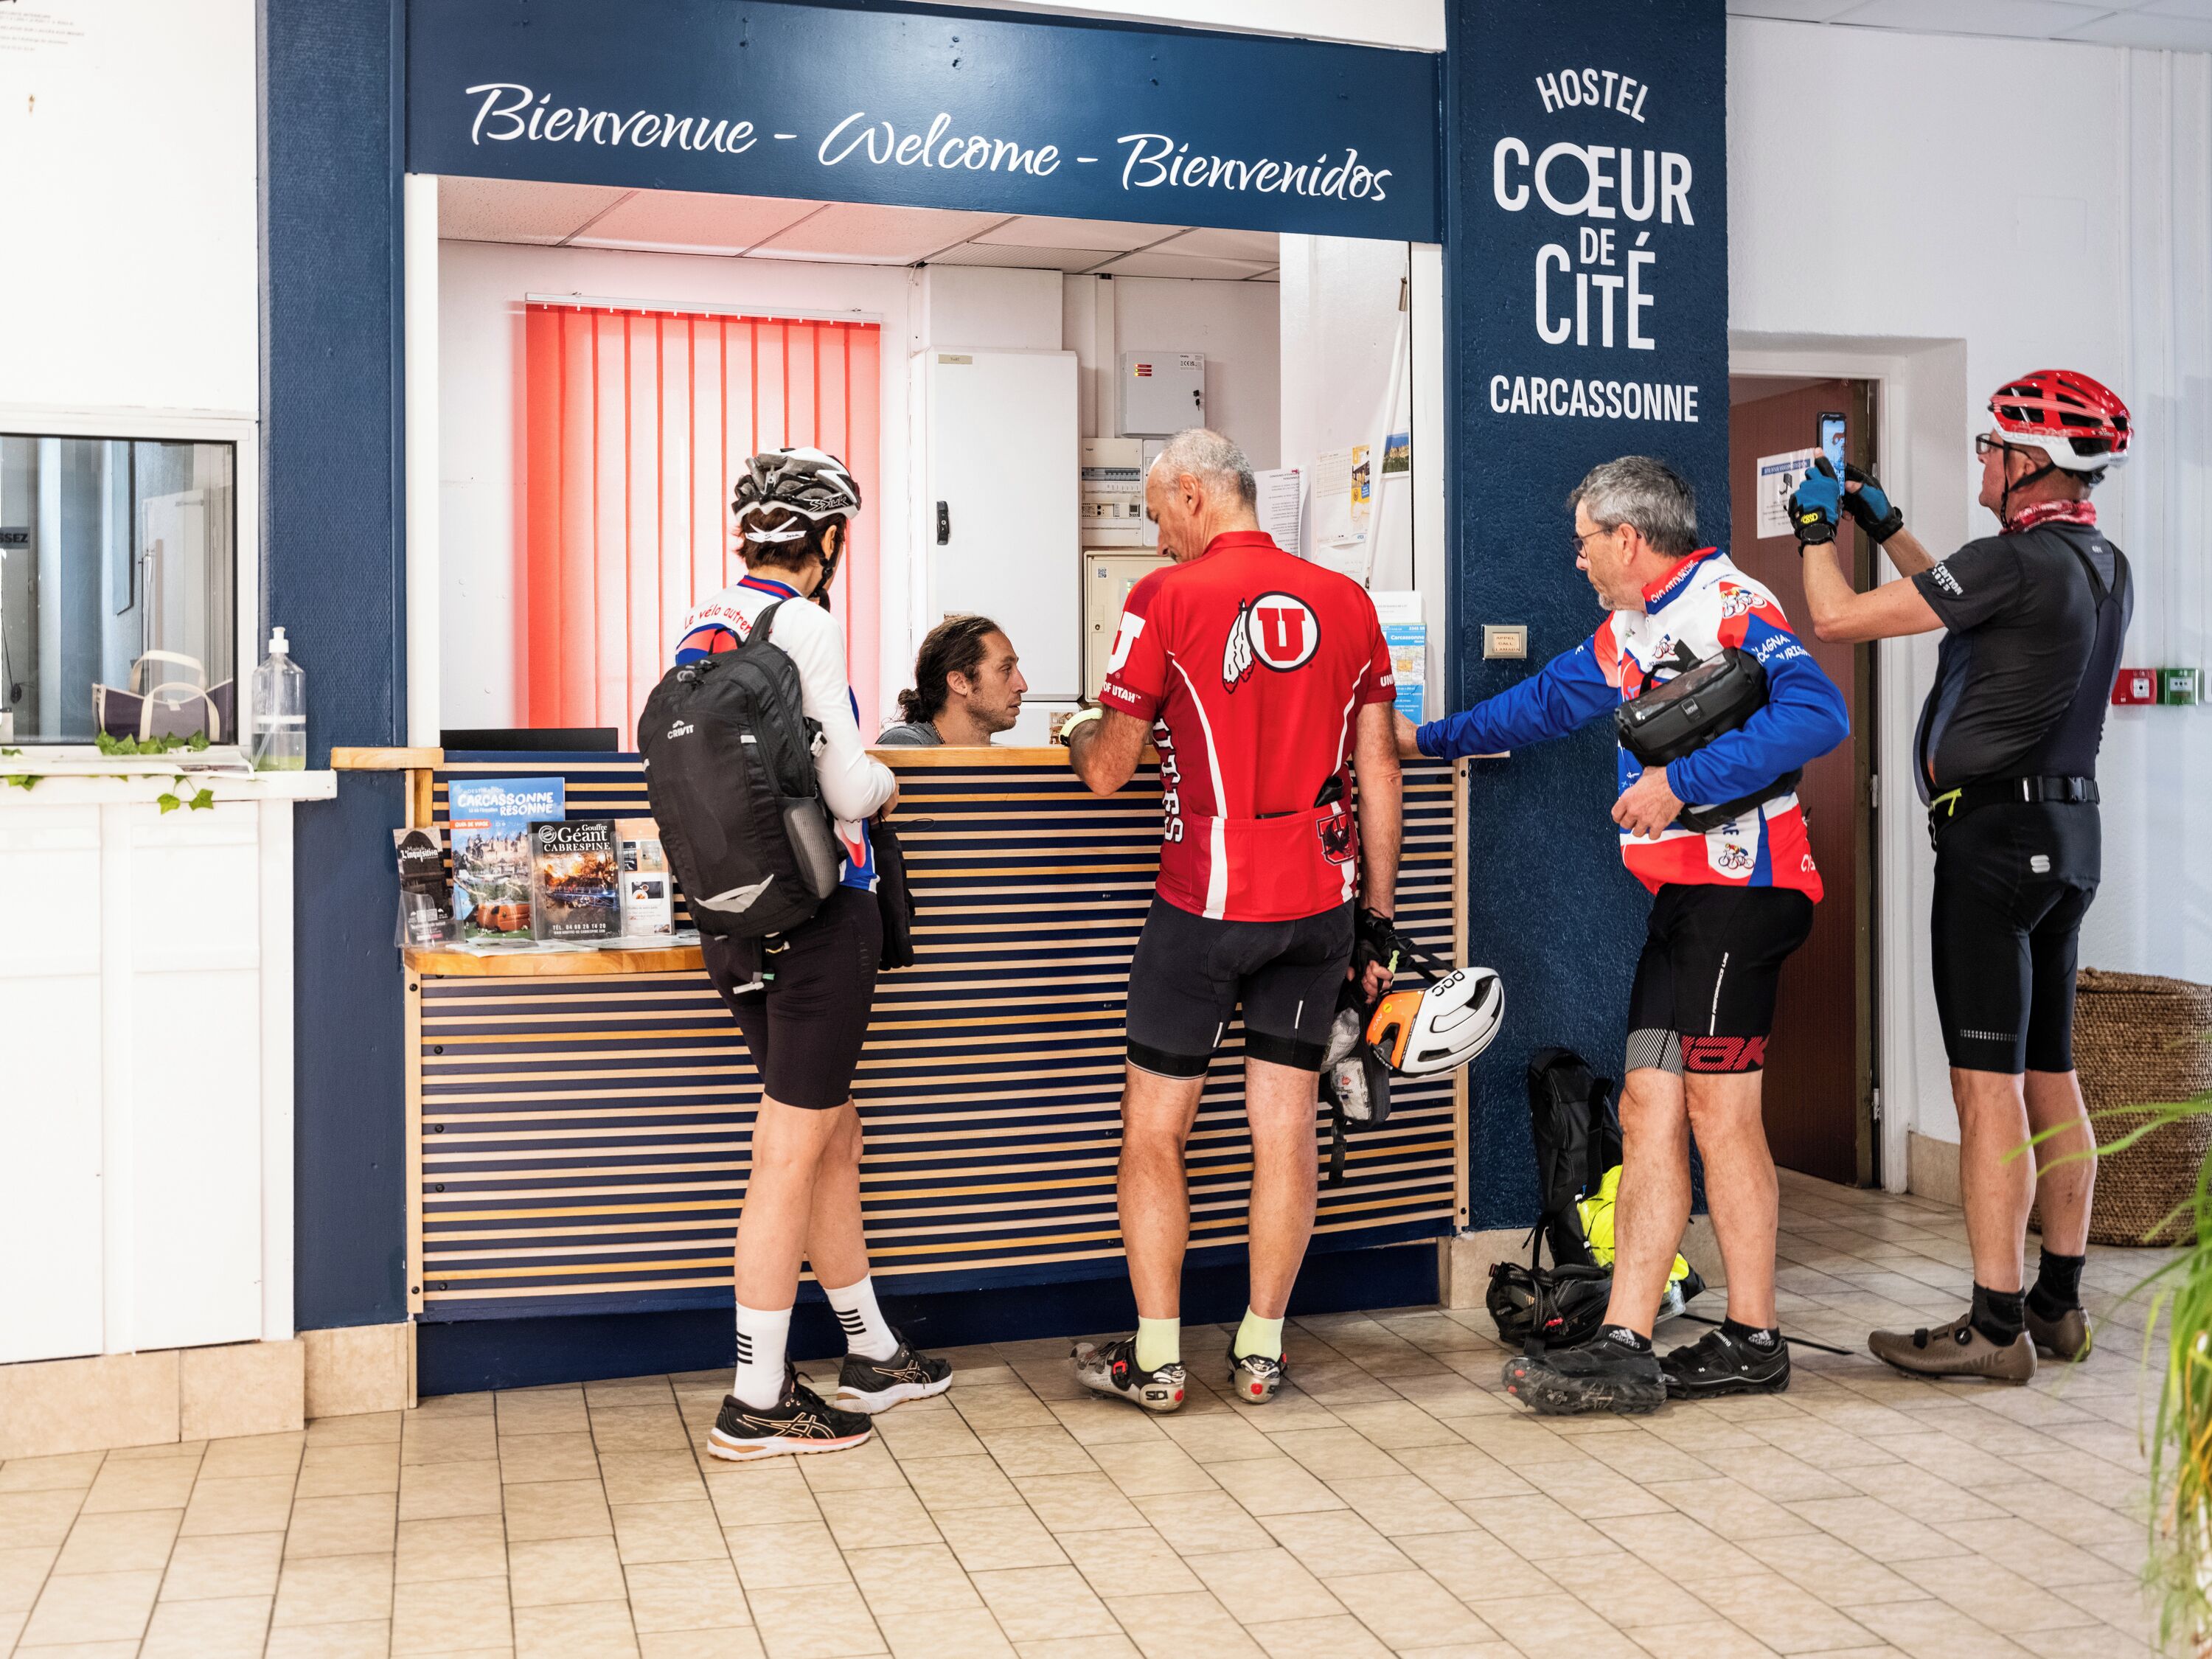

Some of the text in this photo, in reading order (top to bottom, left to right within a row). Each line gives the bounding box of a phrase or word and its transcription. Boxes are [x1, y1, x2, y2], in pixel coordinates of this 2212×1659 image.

[1536, 69, 1648, 122] HOSTEL
[466, 83, 757, 153] Bienvenue
[818, 111, 1060, 176] Welcome
[1118, 133, 1393, 201] Bienvenidos
[1580, 226, 1615, 266] DE
[1535, 231, 1655, 350] CITÉ
[1490, 375, 1699, 422] CARCASSONNE
[684, 615, 694, 630] Le
[699, 604, 721, 619] vélo
[1256, 608, 1306, 661] U
[1103, 681, 1112, 693] OF
[667, 724, 694, 740] CRIVIT
[458, 792, 553, 807] CARCASSONNE
[557, 827, 608, 843] Géant
[543, 842, 611, 852] CABRESPINE
[1609, 1332, 1641, 1349] adidas
[1146, 1390, 1169, 1401] SIDI
